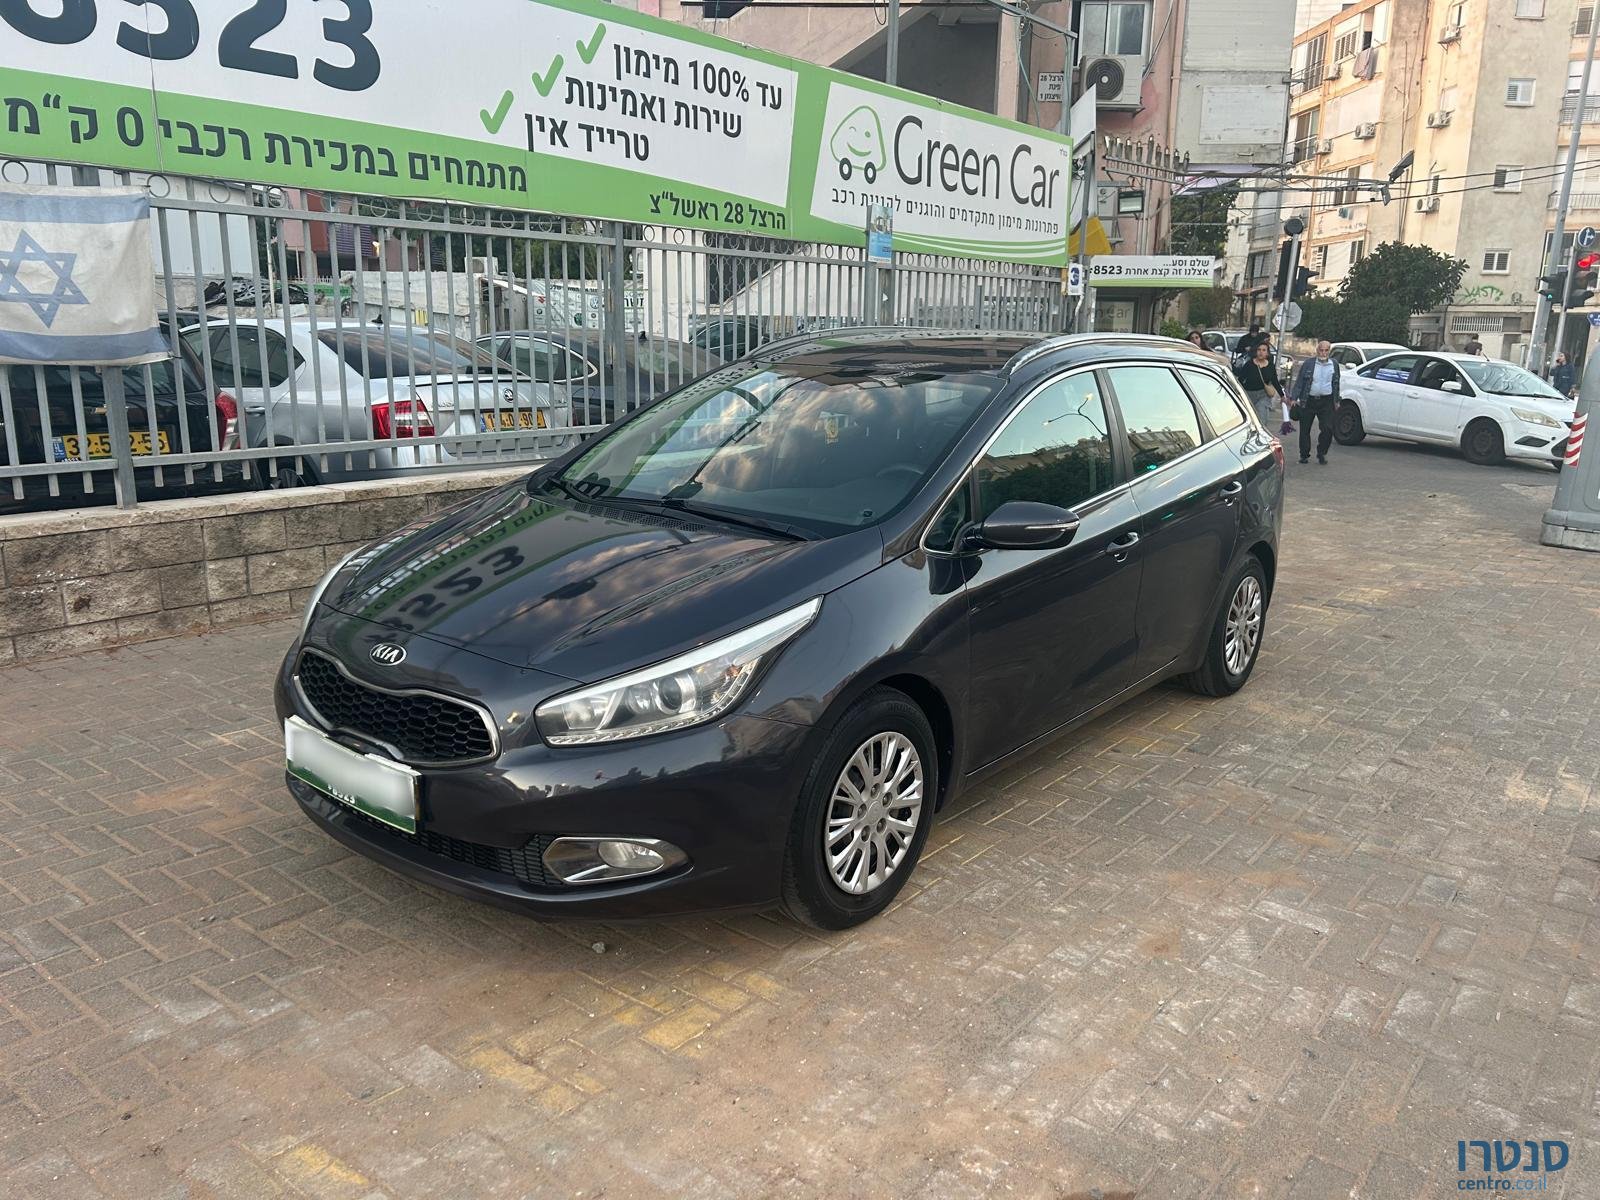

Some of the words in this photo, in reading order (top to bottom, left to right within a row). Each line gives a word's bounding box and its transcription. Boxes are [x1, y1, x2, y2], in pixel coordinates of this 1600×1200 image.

[613, 43, 680, 86] מימון
[688, 59, 749, 102] 100%
[564, 75, 666, 122] ואמינות
[756, 81, 783, 110] עד
[116, 106, 145, 147] 0
[523, 112, 570, 152] אין
[673, 100, 743, 139] שירות
[158, 118, 252, 161] רכבי
[577, 122, 650, 161] טרייד
[263, 131, 399, 178] במכירת
[893, 115, 1000, 199] Green
[1010, 143, 1060, 209] Car
[407, 151, 528, 192] מתמחים
[831, 188, 855, 205] רכב
[906, 199, 945, 218] והוגנים
[723, 200, 745, 224] 28
[748, 203, 786, 230] הרצל
[949, 206, 994, 226] מתקדמים
[998, 214, 1023, 231] מימון
[1025, 218, 1059, 235] פתרונות
[1125, 267, 1149, 276] אחרת
[1151, 268, 1170, 277] קצת
[1172, 267, 1182, 276] זה
[1184, 267, 1209, 276] אצלנו
[1190, 259, 1210, 267] שלם
[371, 644, 400, 663] KIA
